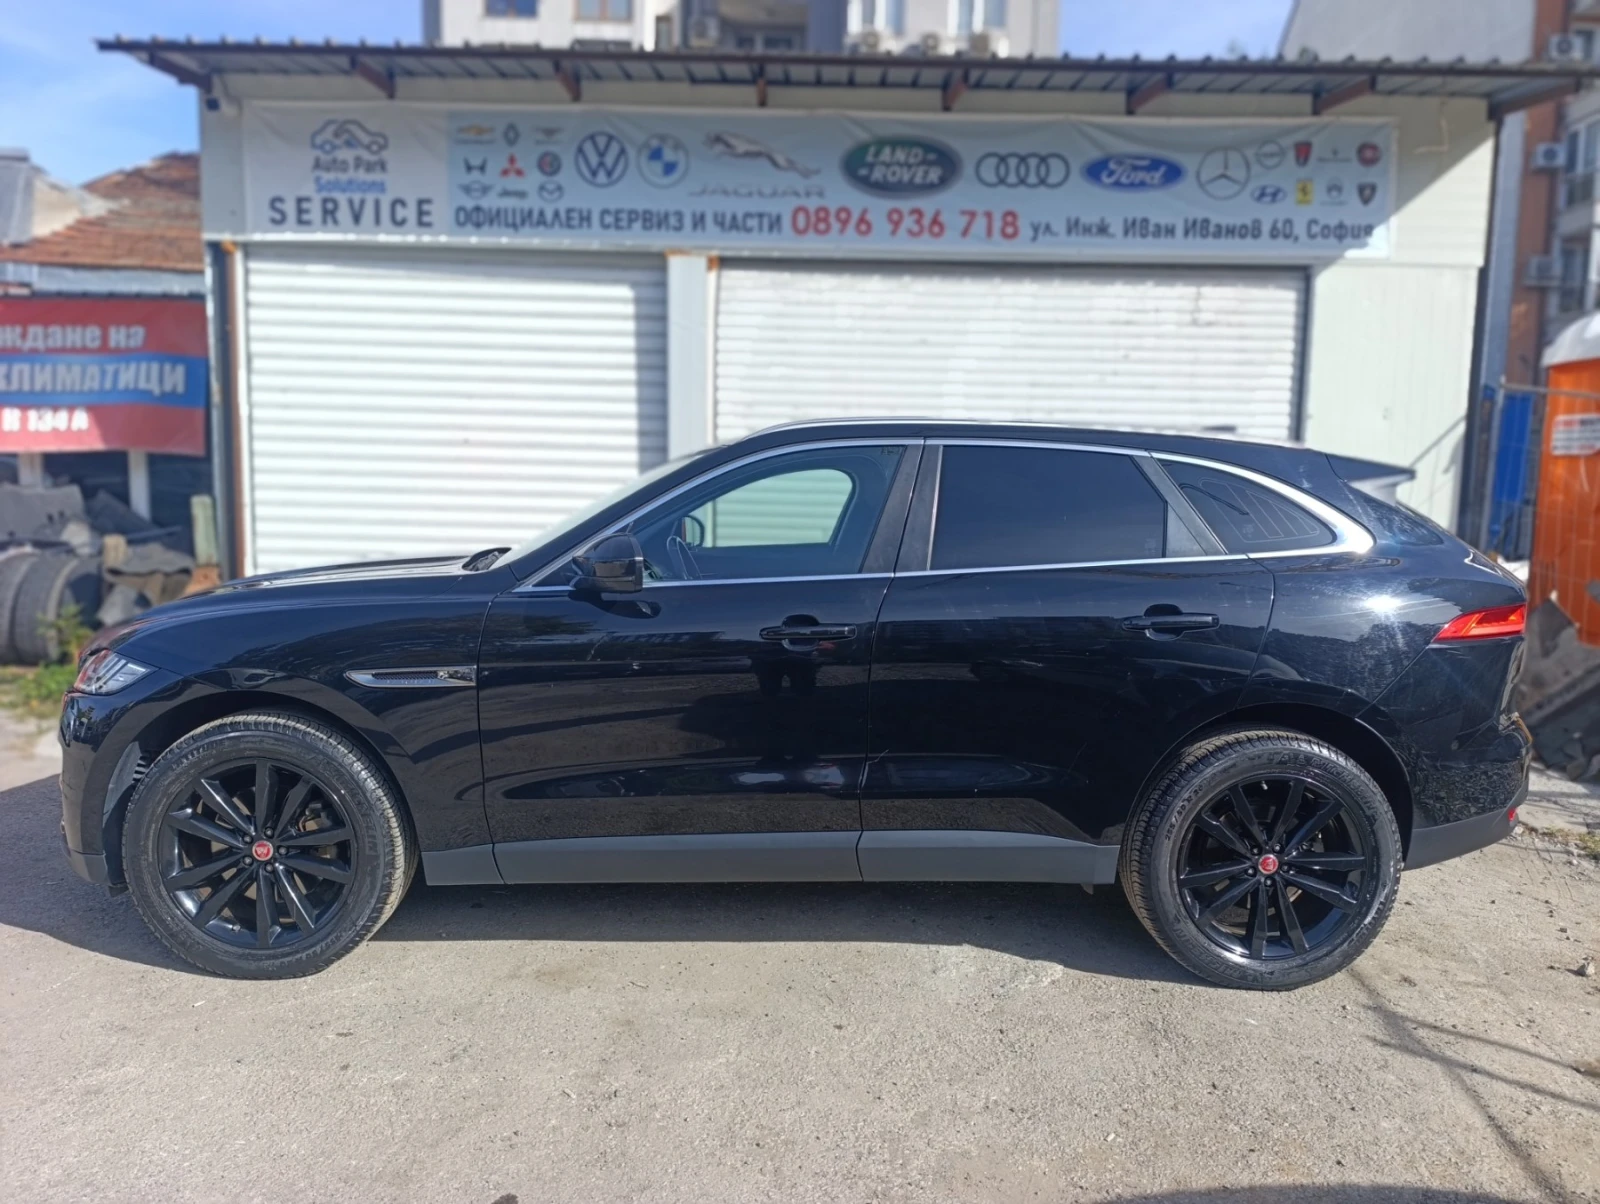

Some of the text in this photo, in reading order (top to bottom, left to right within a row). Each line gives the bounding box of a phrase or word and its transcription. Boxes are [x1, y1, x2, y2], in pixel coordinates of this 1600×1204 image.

[311, 154, 389, 174] Auto Park
[1098, 157, 1165, 186] Ford
[313, 175, 387, 195] Solutions
[688, 184, 825, 199] JAGUAR
[268, 196, 434, 228] SERVICE
[455, 205, 592, 232] ОФИЦИАЛЕН
[600, 208, 684, 232] СЕРВИЗ
[691, 209, 706, 233] И
[712, 210, 783, 235] ЧАСТИ
[791, 204, 872, 237] 0896
[886, 206, 945, 239] 936
[959, 209, 1020, 241] 718
[1122, 216, 1176, 239] Иван
[1183, 217, 1262, 241] Иванов
[1269, 217, 1300, 244] 60,
[108, 325, 146, 349] на
